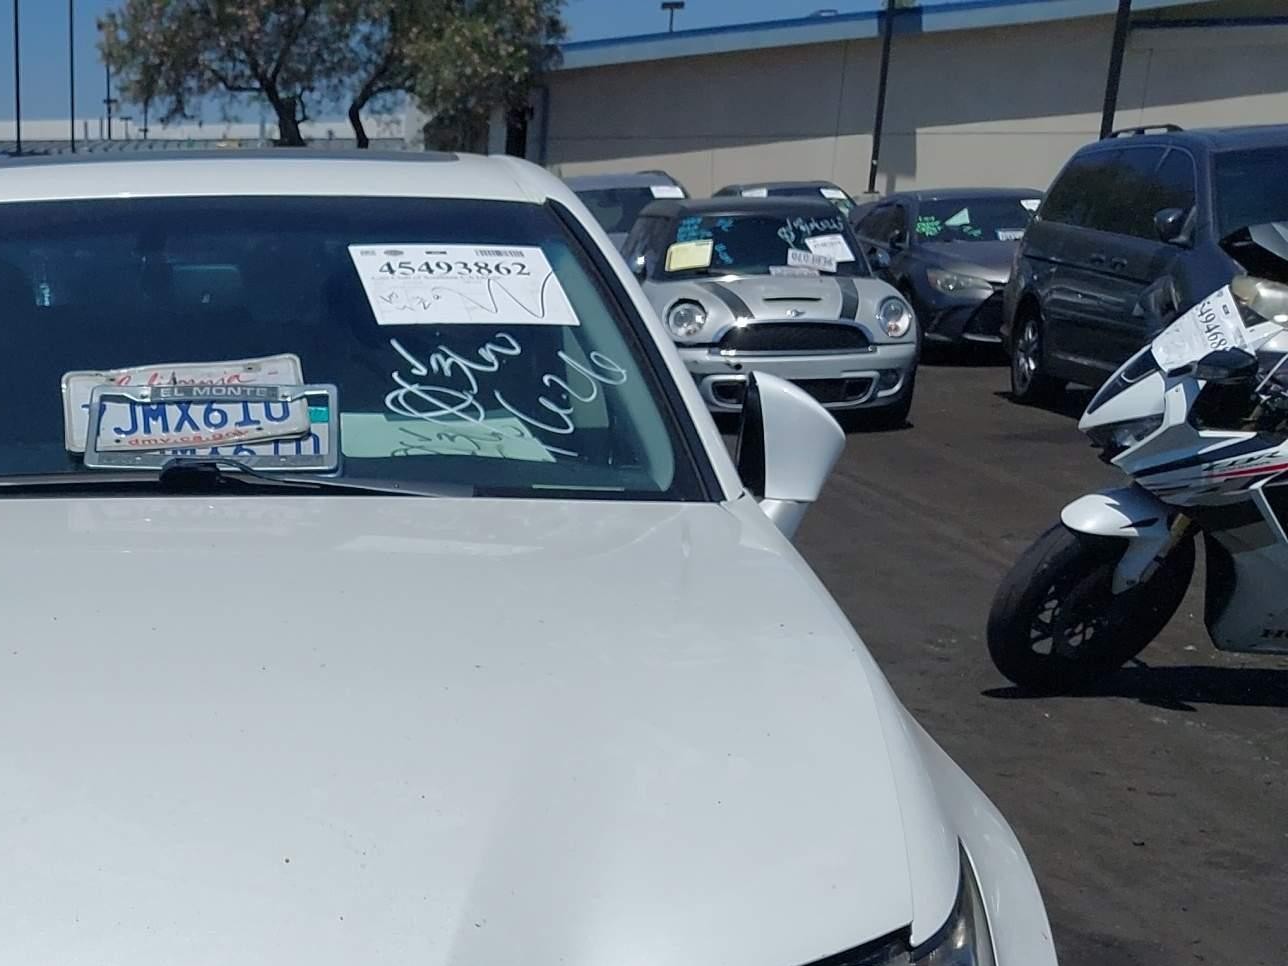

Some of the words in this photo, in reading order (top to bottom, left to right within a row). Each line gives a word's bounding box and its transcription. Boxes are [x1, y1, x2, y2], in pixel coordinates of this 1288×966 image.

[378, 260, 531, 277] 45493862
[159, 386, 185, 398] EL
[191, 385, 268, 398] MONTE
[127, 428, 251, 447] dmv.ca.gov
